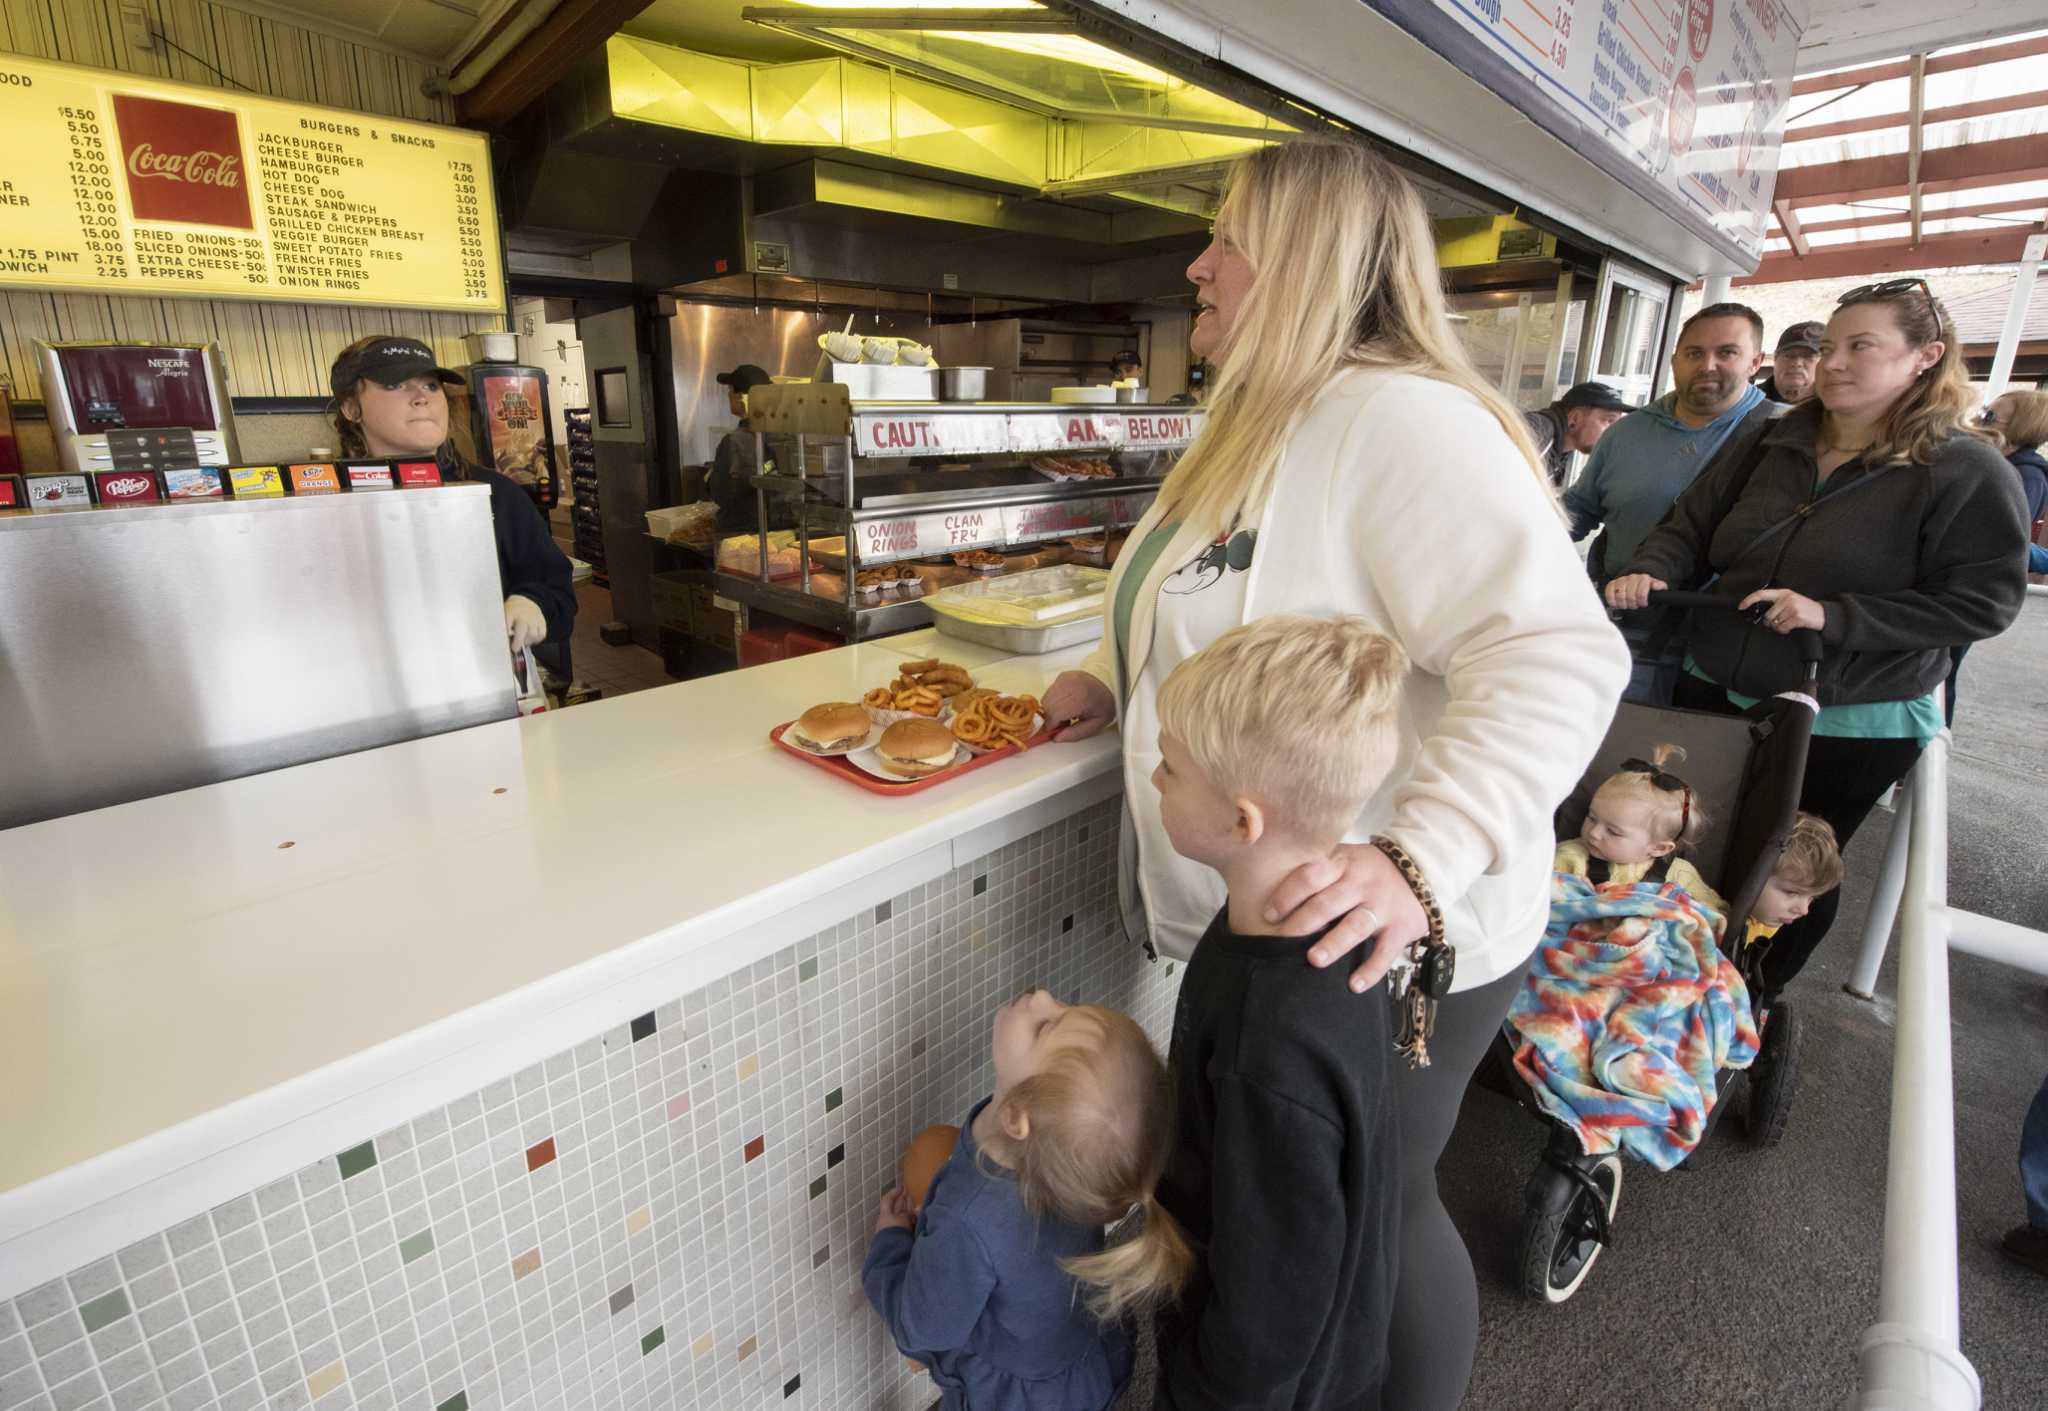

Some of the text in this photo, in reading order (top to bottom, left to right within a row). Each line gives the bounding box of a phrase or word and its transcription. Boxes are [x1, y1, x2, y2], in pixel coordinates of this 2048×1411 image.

[1555, 6, 1572, 38] 3.25
[1552, 39, 1567, 69] 4.50
[0, 72, 32, 87] OOD
[67, 121, 99, 135] 5.50
[300, 119, 435, 148] BURGERS & SNACKS
[70, 134, 102, 148] 6.75
[258, 133, 344, 153] JACKBURGER
[73, 149, 105, 161] 5.00
[69, 161, 109, 175] 12.00
[128, 143, 240, 188] Coca-Cola
[258, 145, 474, 183] CHEESE BURGER 4.00
[71, 175, 111, 188] 12.00
[260, 157, 476, 194] HAMBURGER 3.50
[74, 188, 114, 201] 12.00
[263, 169, 477, 205] HOT DOG 3.00
[0, 194, 30, 206] NER
[263, 181, 478, 216] CHEESE DOG 3.50
[265, 193, 308, 208] STEAK
[315, 200, 377, 215] SANDWICH
[76, 201, 117, 214] 13.00
[80, 215, 117, 227] 12.00
[267, 206, 480, 237] SAUSAGE & PEPPERS 5.50
[269, 218, 322, 231] GRILLED
[327, 223, 377, 237] CHICKEN
[381, 229, 424, 241] BREAST
[82, 228, 120, 240] 15.00
[134, 229, 173, 241] FRIED
[86, 241, 123, 252] 18.00
[134, 241, 183, 253] SLICED
[272, 230, 483, 257] VEGGIE BURGER 4.50
[8, 248, 125, 266] 1.75 PINT 3.75
[137, 255, 183, 266] EXTRA
[273, 241, 485, 268] SWEET POTATO FRIES 4.00
[0, 261, 128, 278] DWICH 2.25
[141, 267, 204, 280] PEPPERS
[276, 253, 486, 278] FRENCH FRIES 3.25
[277, 265, 486, 288] TWISTER FRIES 3.50
[278, 276, 487, 298] ONION RINGS 3.75
[119, 478, 135, 488] Dr
[365, 472, 389, 480] Coke
[109, 480, 147, 496] Pepper
[867, 521, 916, 538] ONION
[945, 513, 983, 530] CLAM
[872, 535, 918, 554] RINGS
